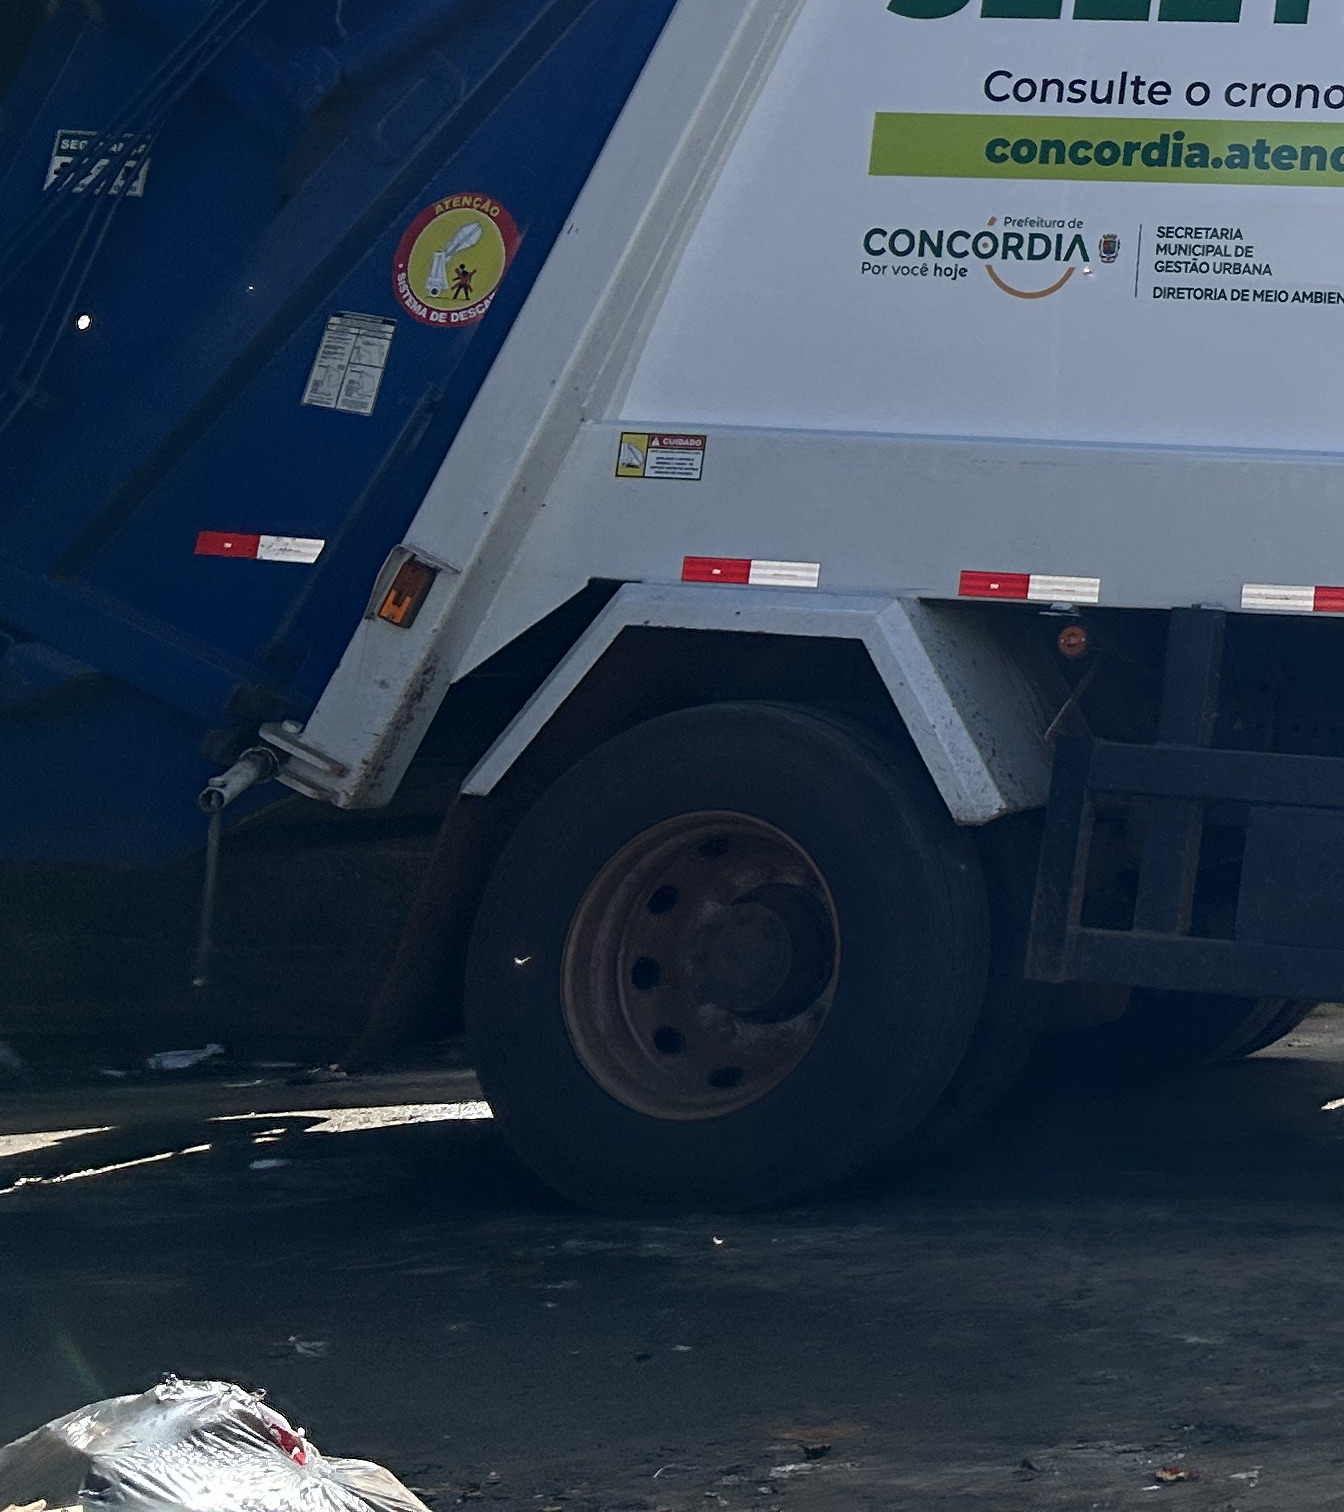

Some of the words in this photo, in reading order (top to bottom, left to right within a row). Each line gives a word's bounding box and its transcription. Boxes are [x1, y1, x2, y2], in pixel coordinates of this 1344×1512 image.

[983, 69, 1172, 107] Consulte
[1185, 81, 1211, 107] o
[434, 195, 501, 217] ATENÇÃO
[1003, 215, 1066, 230] Prefeitura
[1067, 217, 1084, 230] de
[863, 216, 1090, 263] CONCÓRDIA
[1156, 225, 1244, 241] SECRETARIA
[1155, 242, 1232, 258] MUNICIPAL
[1233, 244, 1255, 259] DE
[861, 261, 887, 276] Por
[891, 262, 930, 277] você
[933, 262, 969, 279] hoje
[1153, 257, 1210, 275] GESTÃO
[1212, 261, 1273, 277] URBANA
[397, 272, 428, 318] SISTEMA
[429, 311, 448, 322] DE
[1152, 286, 1228, 302] DIRETORIA
[1230, 288, 1250, 303] DE
[1252, 289, 1290, 304] MEIO
